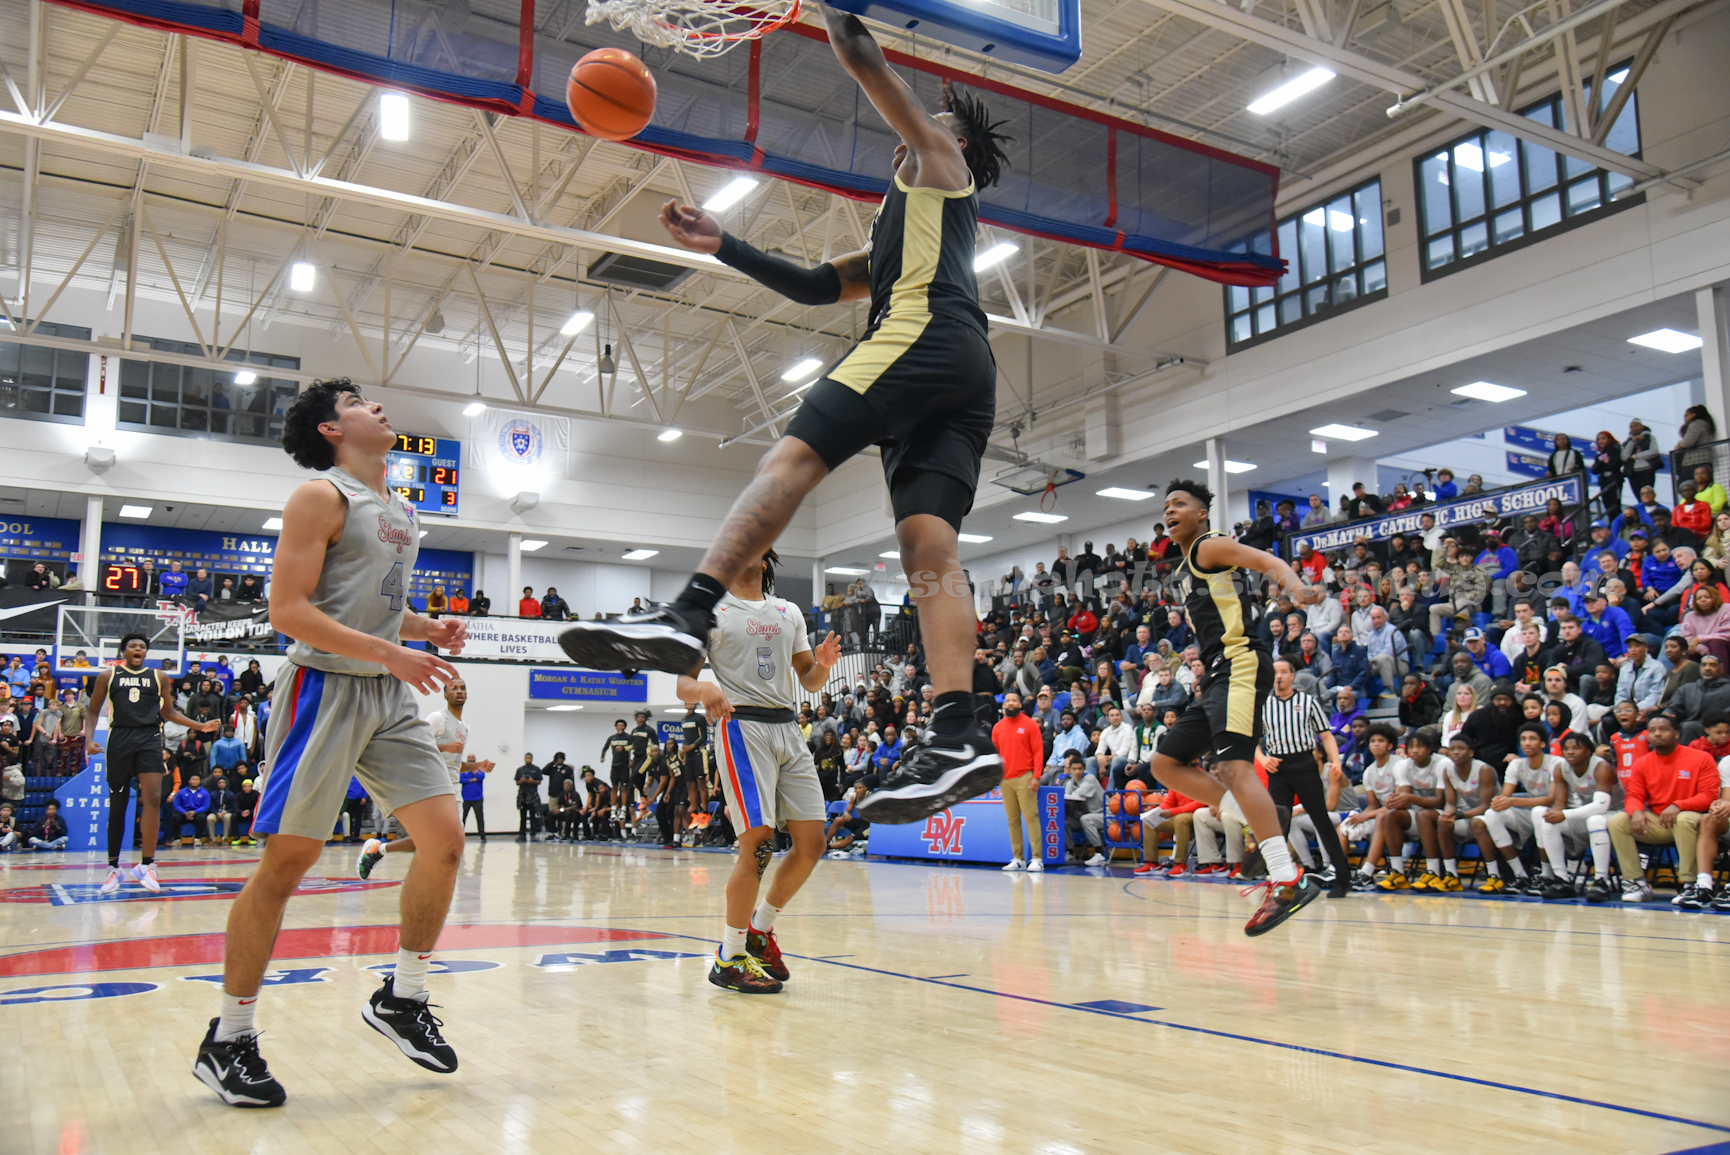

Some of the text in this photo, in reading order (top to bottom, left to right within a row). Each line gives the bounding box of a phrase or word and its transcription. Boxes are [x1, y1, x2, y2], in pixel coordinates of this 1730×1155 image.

[397, 434, 434, 454] 7:13
[432, 458, 456, 467] GUEST
[403, 465, 414, 479] 2
[434, 467, 457, 484] 21
[446, 492, 455, 505] 3
[1378, 509, 1448, 536] CATHOIC
[1501, 485, 1569, 512] SCHOOL
[378, 515, 412, 554] Stags
[222, 537, 272, 553] HALL
[106, 567, 138, 589] 27
[381, 562, 403, 611] 4
[227, 618, 253, 629] KEEPS
[746, 617, 782, 641] Stags
[195, 622, 273, 642] YOU ON TOP
[500, 645, 528, 654] LIVES
[756, 646, 776, 681] 5
[119, 677, 151, 688] PAUL VI
[534, 673, 568, 683] MORGAN
[580, 676, 606, 685] KATHY
[128, 687, 140, 703] 0
[562, 686, 618, 697] GYMNASIUM
[1623, 752, 1633, 767] 0
[66, 798, 110, 808] STAG
[921, 806, 967, 855] DM
[1046, 792, 1059, 859] STAGS
